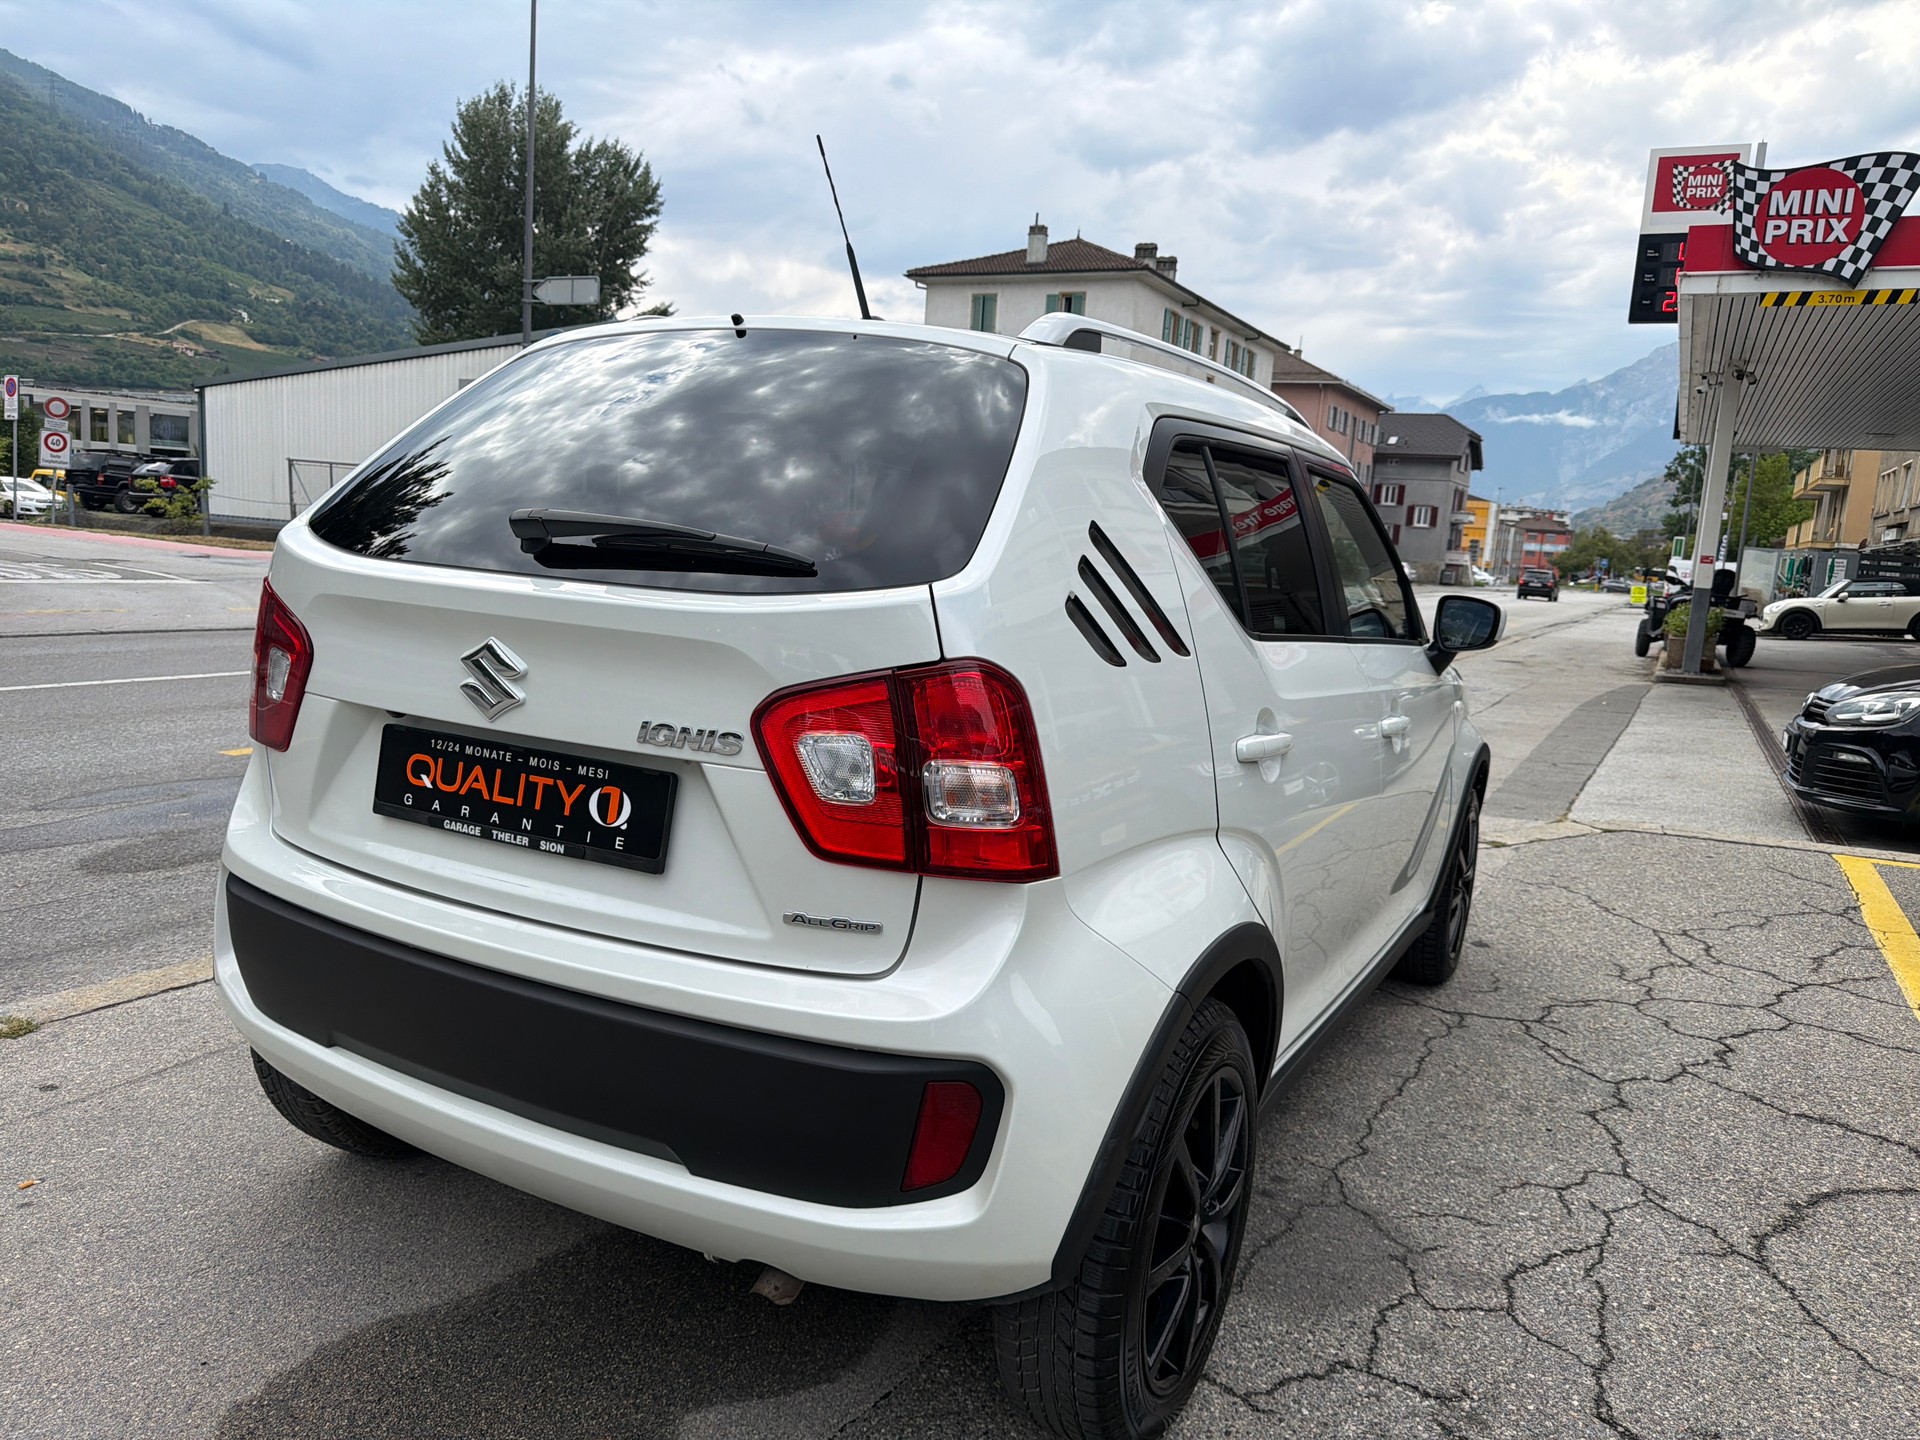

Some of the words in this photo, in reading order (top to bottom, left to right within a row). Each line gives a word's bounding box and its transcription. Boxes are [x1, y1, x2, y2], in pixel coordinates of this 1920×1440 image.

[1685, 185, 1722, 198] PRIX
[1687, 174, 1723, 187] MINI
[1768, 187, 1856, 216] MINI
[1764, 217, 1852, 245] PRIX
[51, 438, 61, 447] 40
[636, 720, 745, 756] IGNIS
[430, 739, 460, 752] 12/24
[465, 745, 513, 763] MONATE
[529, 756, 561, 771] MOIS
[577, 764, 609, 780] MESI
[406, 753, 586, 817] QUALITY
[404, 793, 625, 850] GARANTIE
[443, 819, 481, 836] GARAGE
[491, 830, 529, 847] THELER
[539, 840, 565, 854] SION
